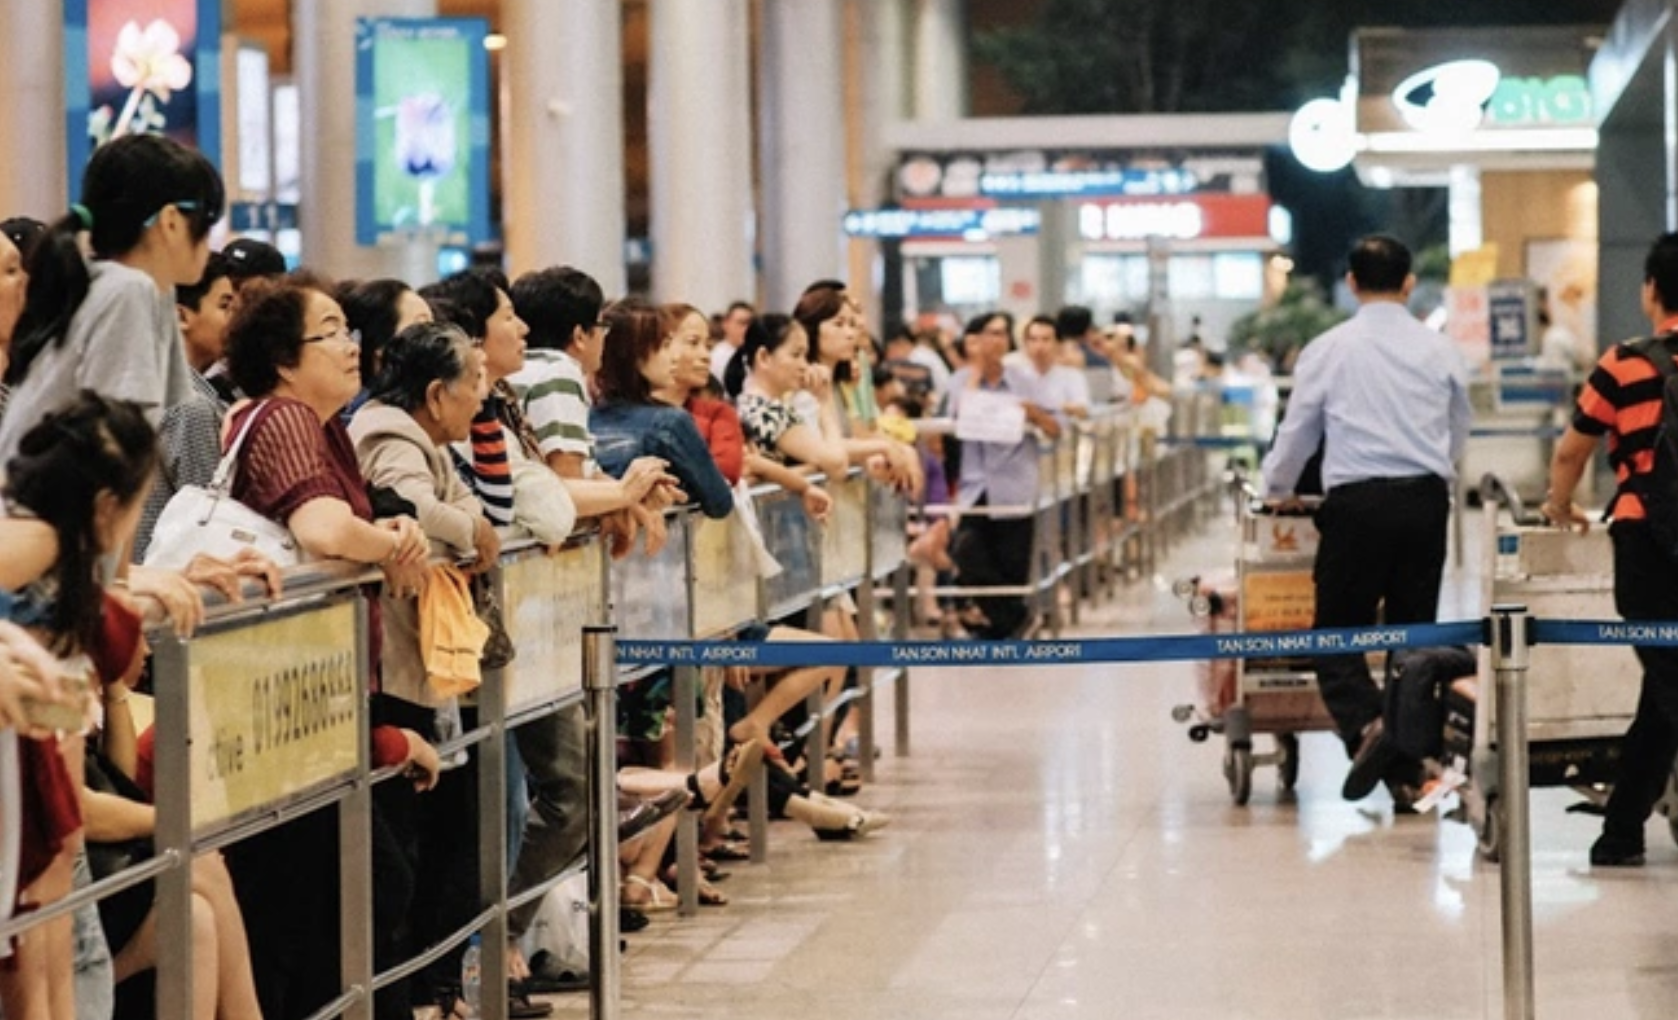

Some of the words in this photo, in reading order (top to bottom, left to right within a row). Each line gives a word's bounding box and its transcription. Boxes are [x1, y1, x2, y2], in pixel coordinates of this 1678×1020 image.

[1598, 624, 1626, 639] TAN
[1627, 625, 1657, 640] SON
[1660, 625, 1678, 641] NH
[1217, 639, 1242, 653] TAN
[1244, 637, 1274, 651] SON
[1278, 635, 1312, 650] NHAT
[1350, 630, 1407, 647] AIRPORT
[629, 645, 664, 660] NHAT
[700, 646, 758, 660] AIRPORT
[892, 646, 919, 660] TAN
[920, 645, 949, 660] SON
[952, 645, 986, 660] NHAT
[1024, 643, 1082, 658] AIRPORT
